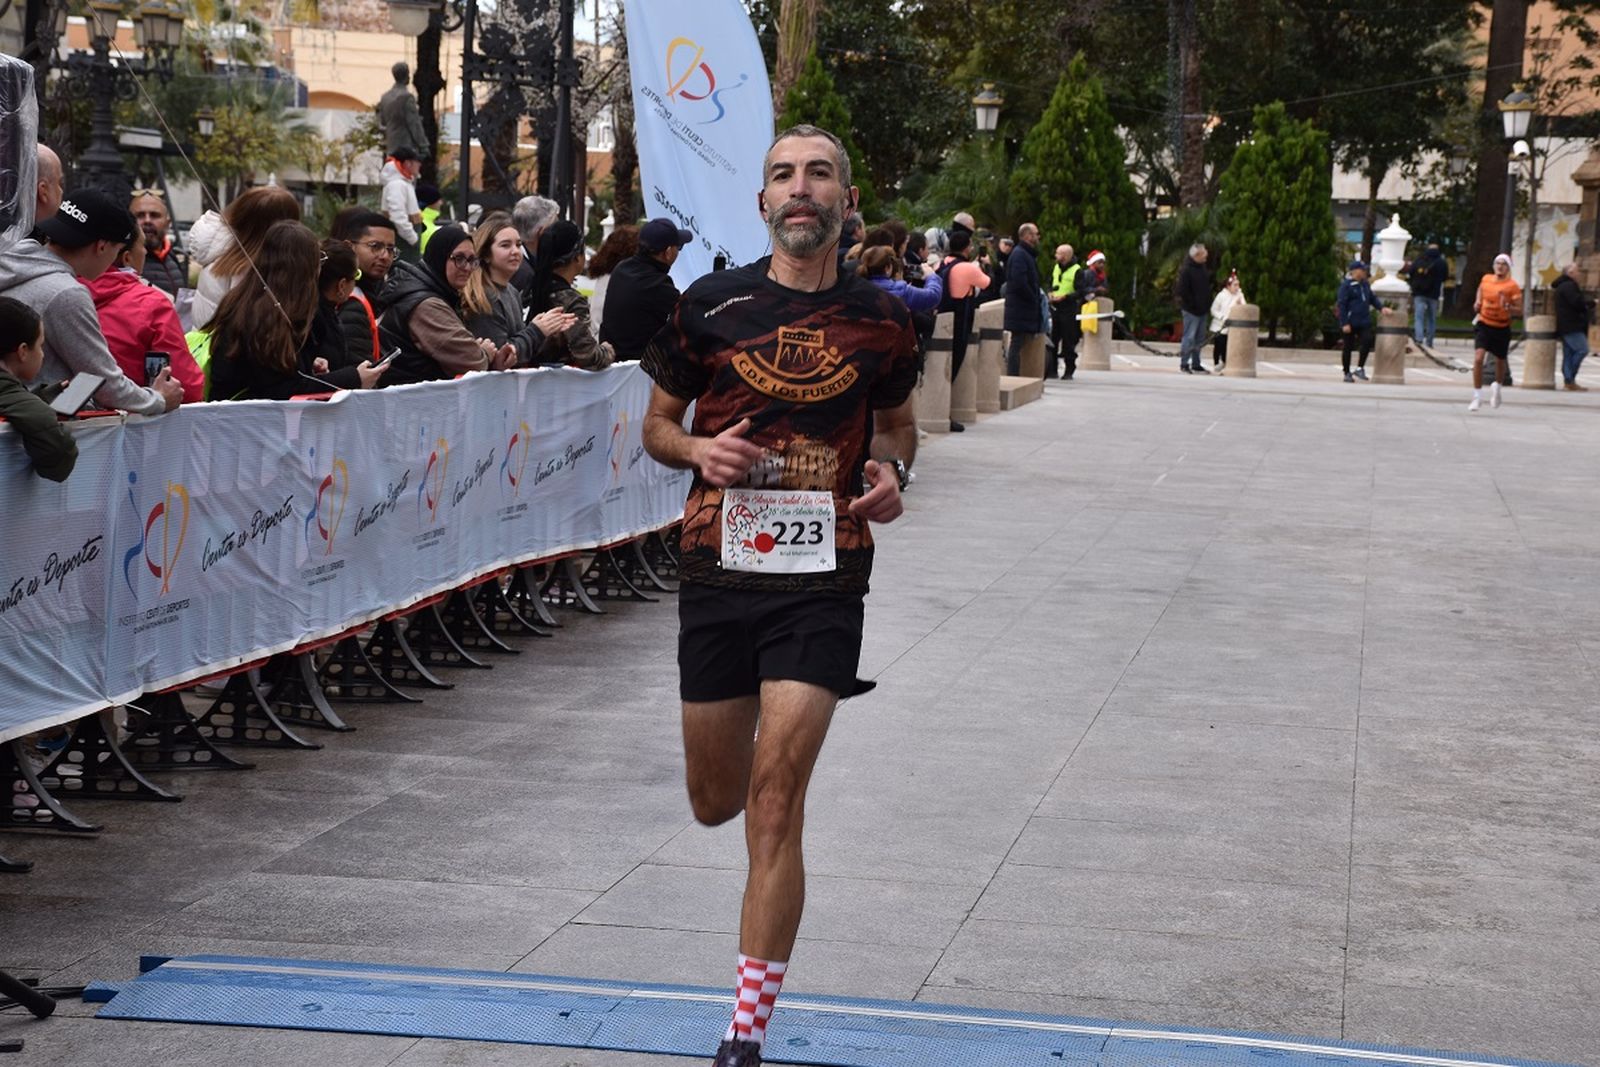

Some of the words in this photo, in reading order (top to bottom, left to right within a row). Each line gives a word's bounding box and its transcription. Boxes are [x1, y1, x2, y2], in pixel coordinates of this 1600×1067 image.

[60, 200, 88, 223] didas
[739, 360, 768, 389] C.D.E.
[771, 383, 798, 398] LOS
[802, 369, 855, 399] FUERTES
[251, 494, 294, 546] Deporte
[771, 520, 824, 546] 223
[44, 534, 103, 594] Deporte
